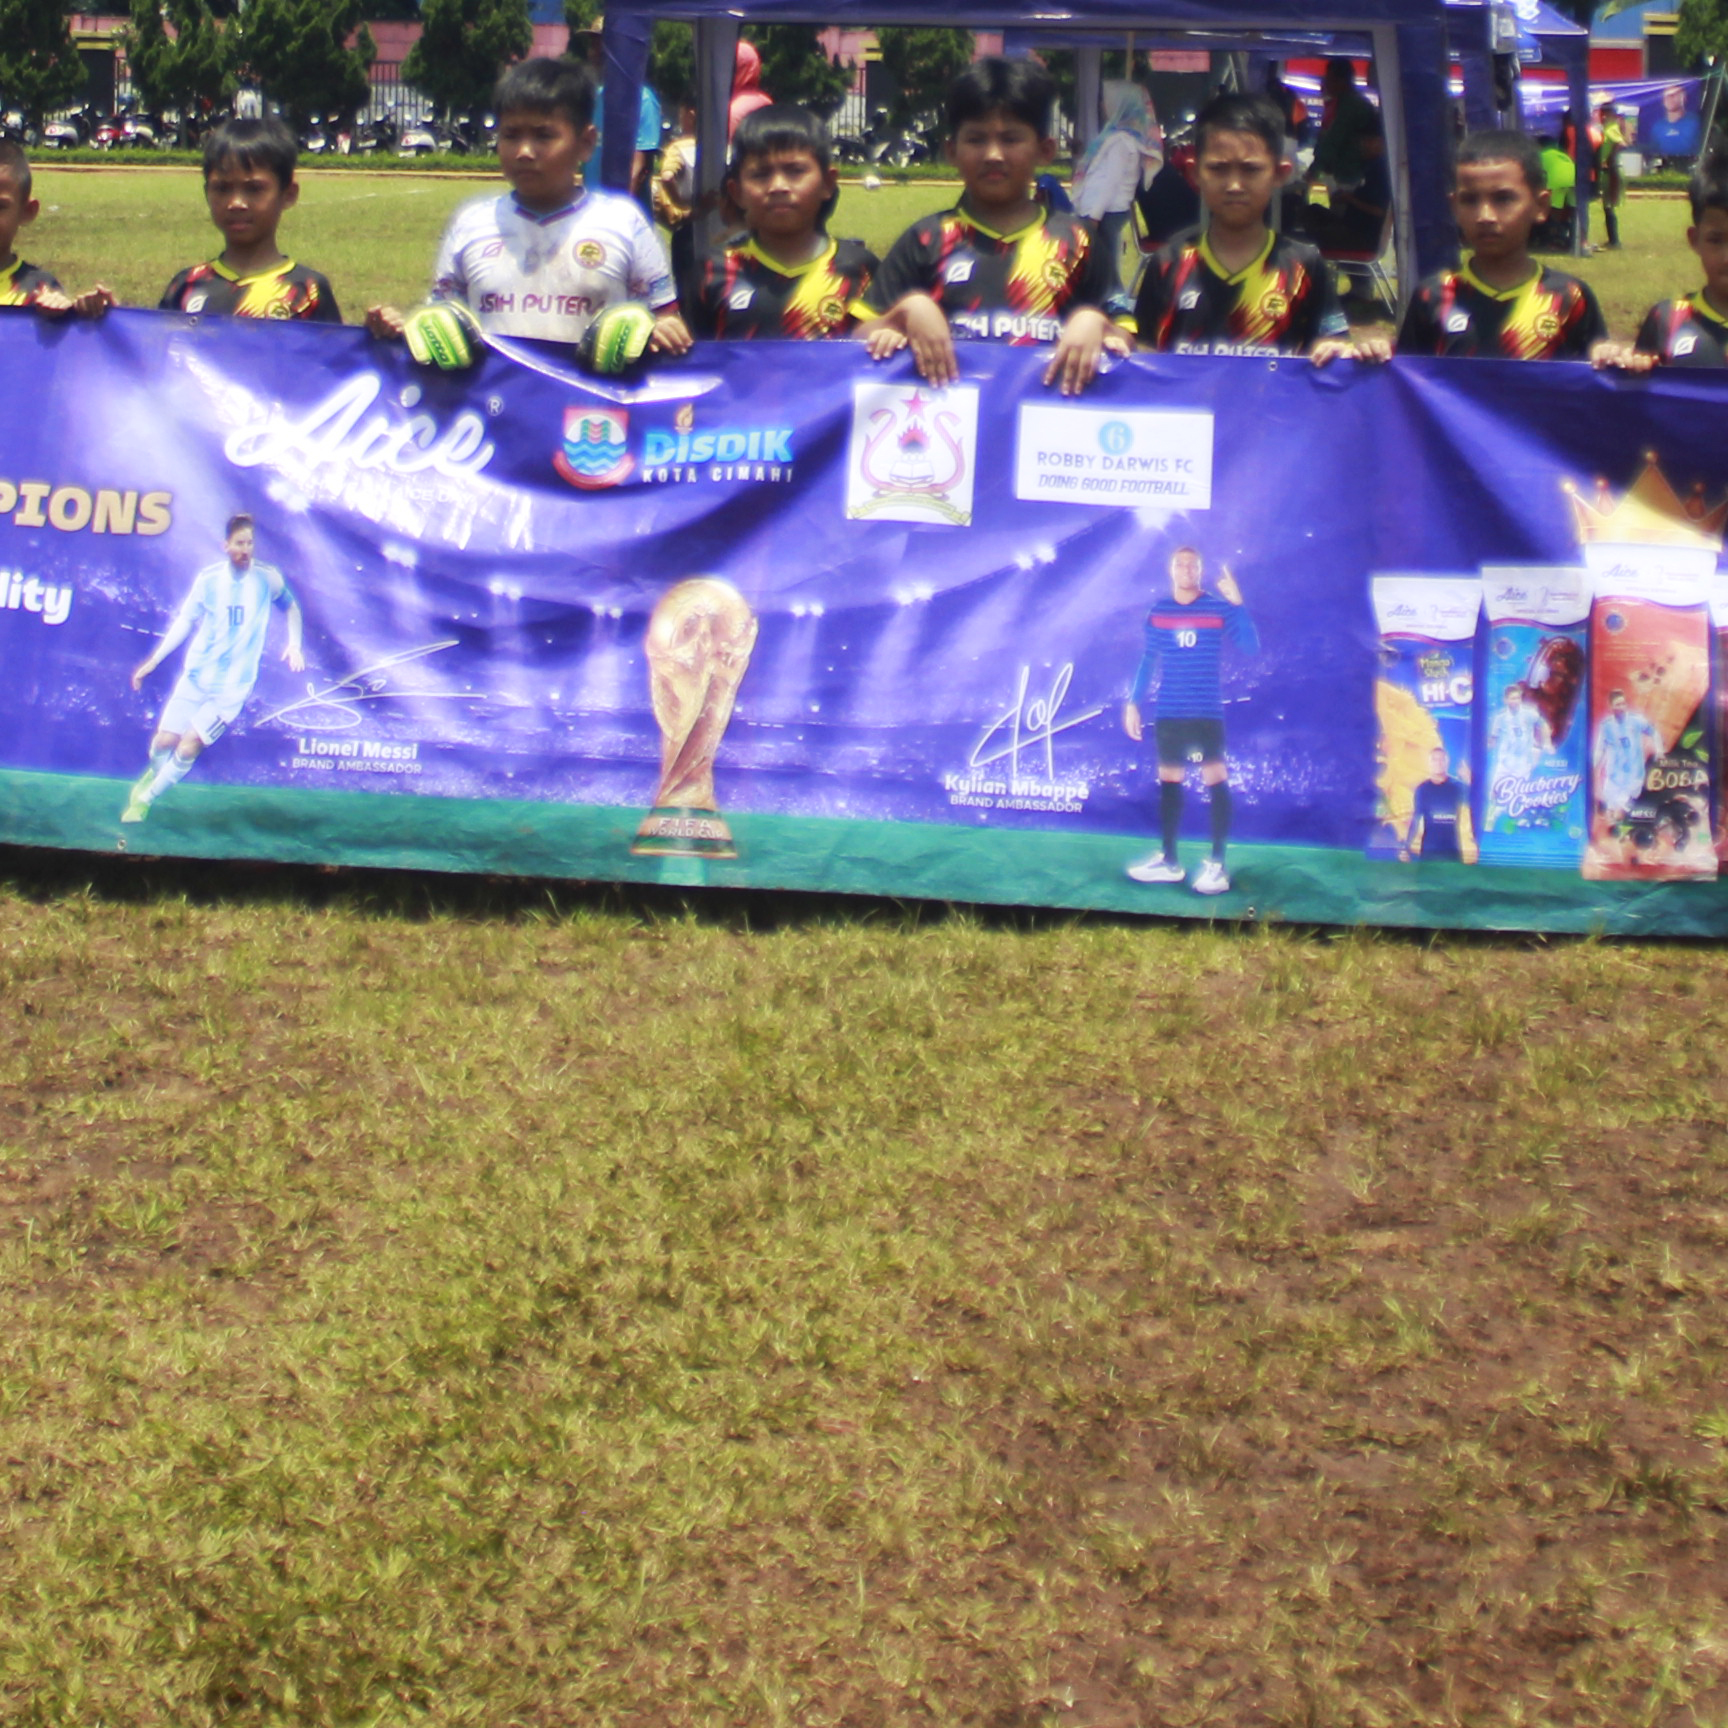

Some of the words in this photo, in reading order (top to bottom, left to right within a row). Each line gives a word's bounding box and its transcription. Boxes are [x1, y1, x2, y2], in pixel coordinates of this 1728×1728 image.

[224, 373, 496, 477] Aice
[1037, 451, 1096, 469] ROBBY
[1102, 455, 1168, 473] DARWIS
[1175, 458, 1193, 474] FC
[642, 467, 697, 483] KOTA
[712, 465, 793, 483] CIMAHI
[1038, 474, 1078, 489] DOING
[1081, 477, 1117, 492] GOOD
[1119, 480, 1190, 496] FOOTBALL
[1175, 631, 1197, 648] 10
[298, 737, 359, 757] Lionel
[362, 740, 419, 759] Messi
[292, 757, 335, 770] BRAND
[337, 760, 422, 774] AMBASSADOR
[944, 773, 1006, 796] Kylian
[1495, 773, 1581, 805] Blueberry
[950, 794, 994, 809] BRAND
[996, 797, 1083, 813] AMBASSADOR
[658, 817, 712, 829] FIFA
